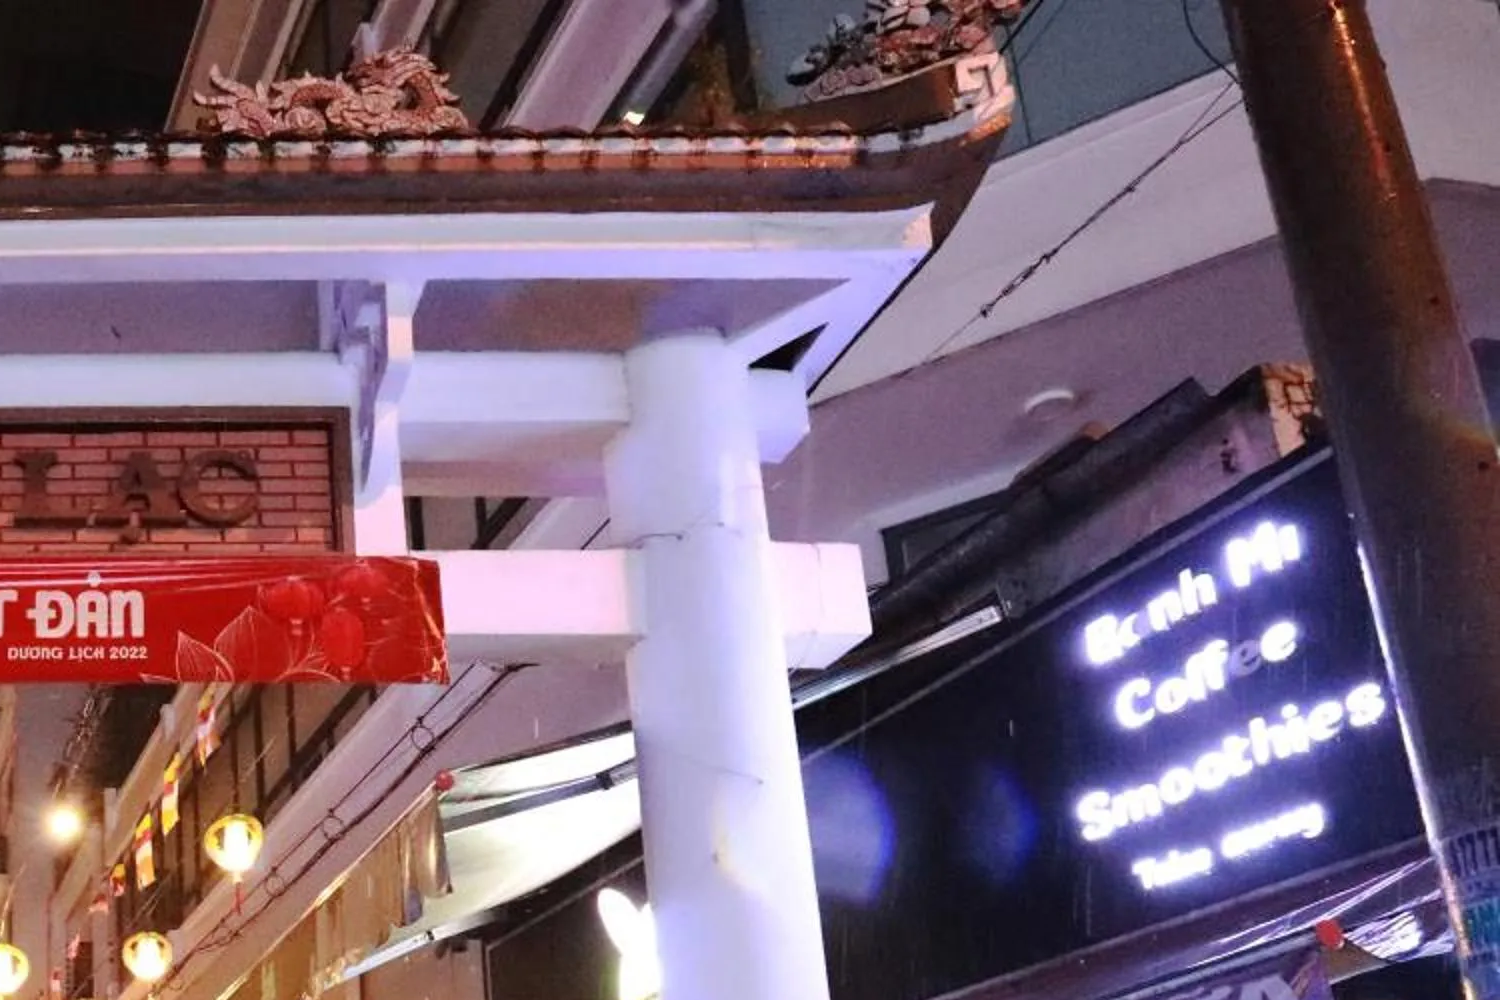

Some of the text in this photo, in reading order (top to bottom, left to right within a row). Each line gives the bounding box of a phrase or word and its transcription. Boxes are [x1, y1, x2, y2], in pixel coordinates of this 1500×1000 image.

[13, 449, 259, 544] LẠC
[26, 570, 145, 639] ĐẢN
[110, 645, 148, 660] 2022
[1115, 621, 1298, 728] Coffee
[1077, 682, 1386, 841] Smoothies
